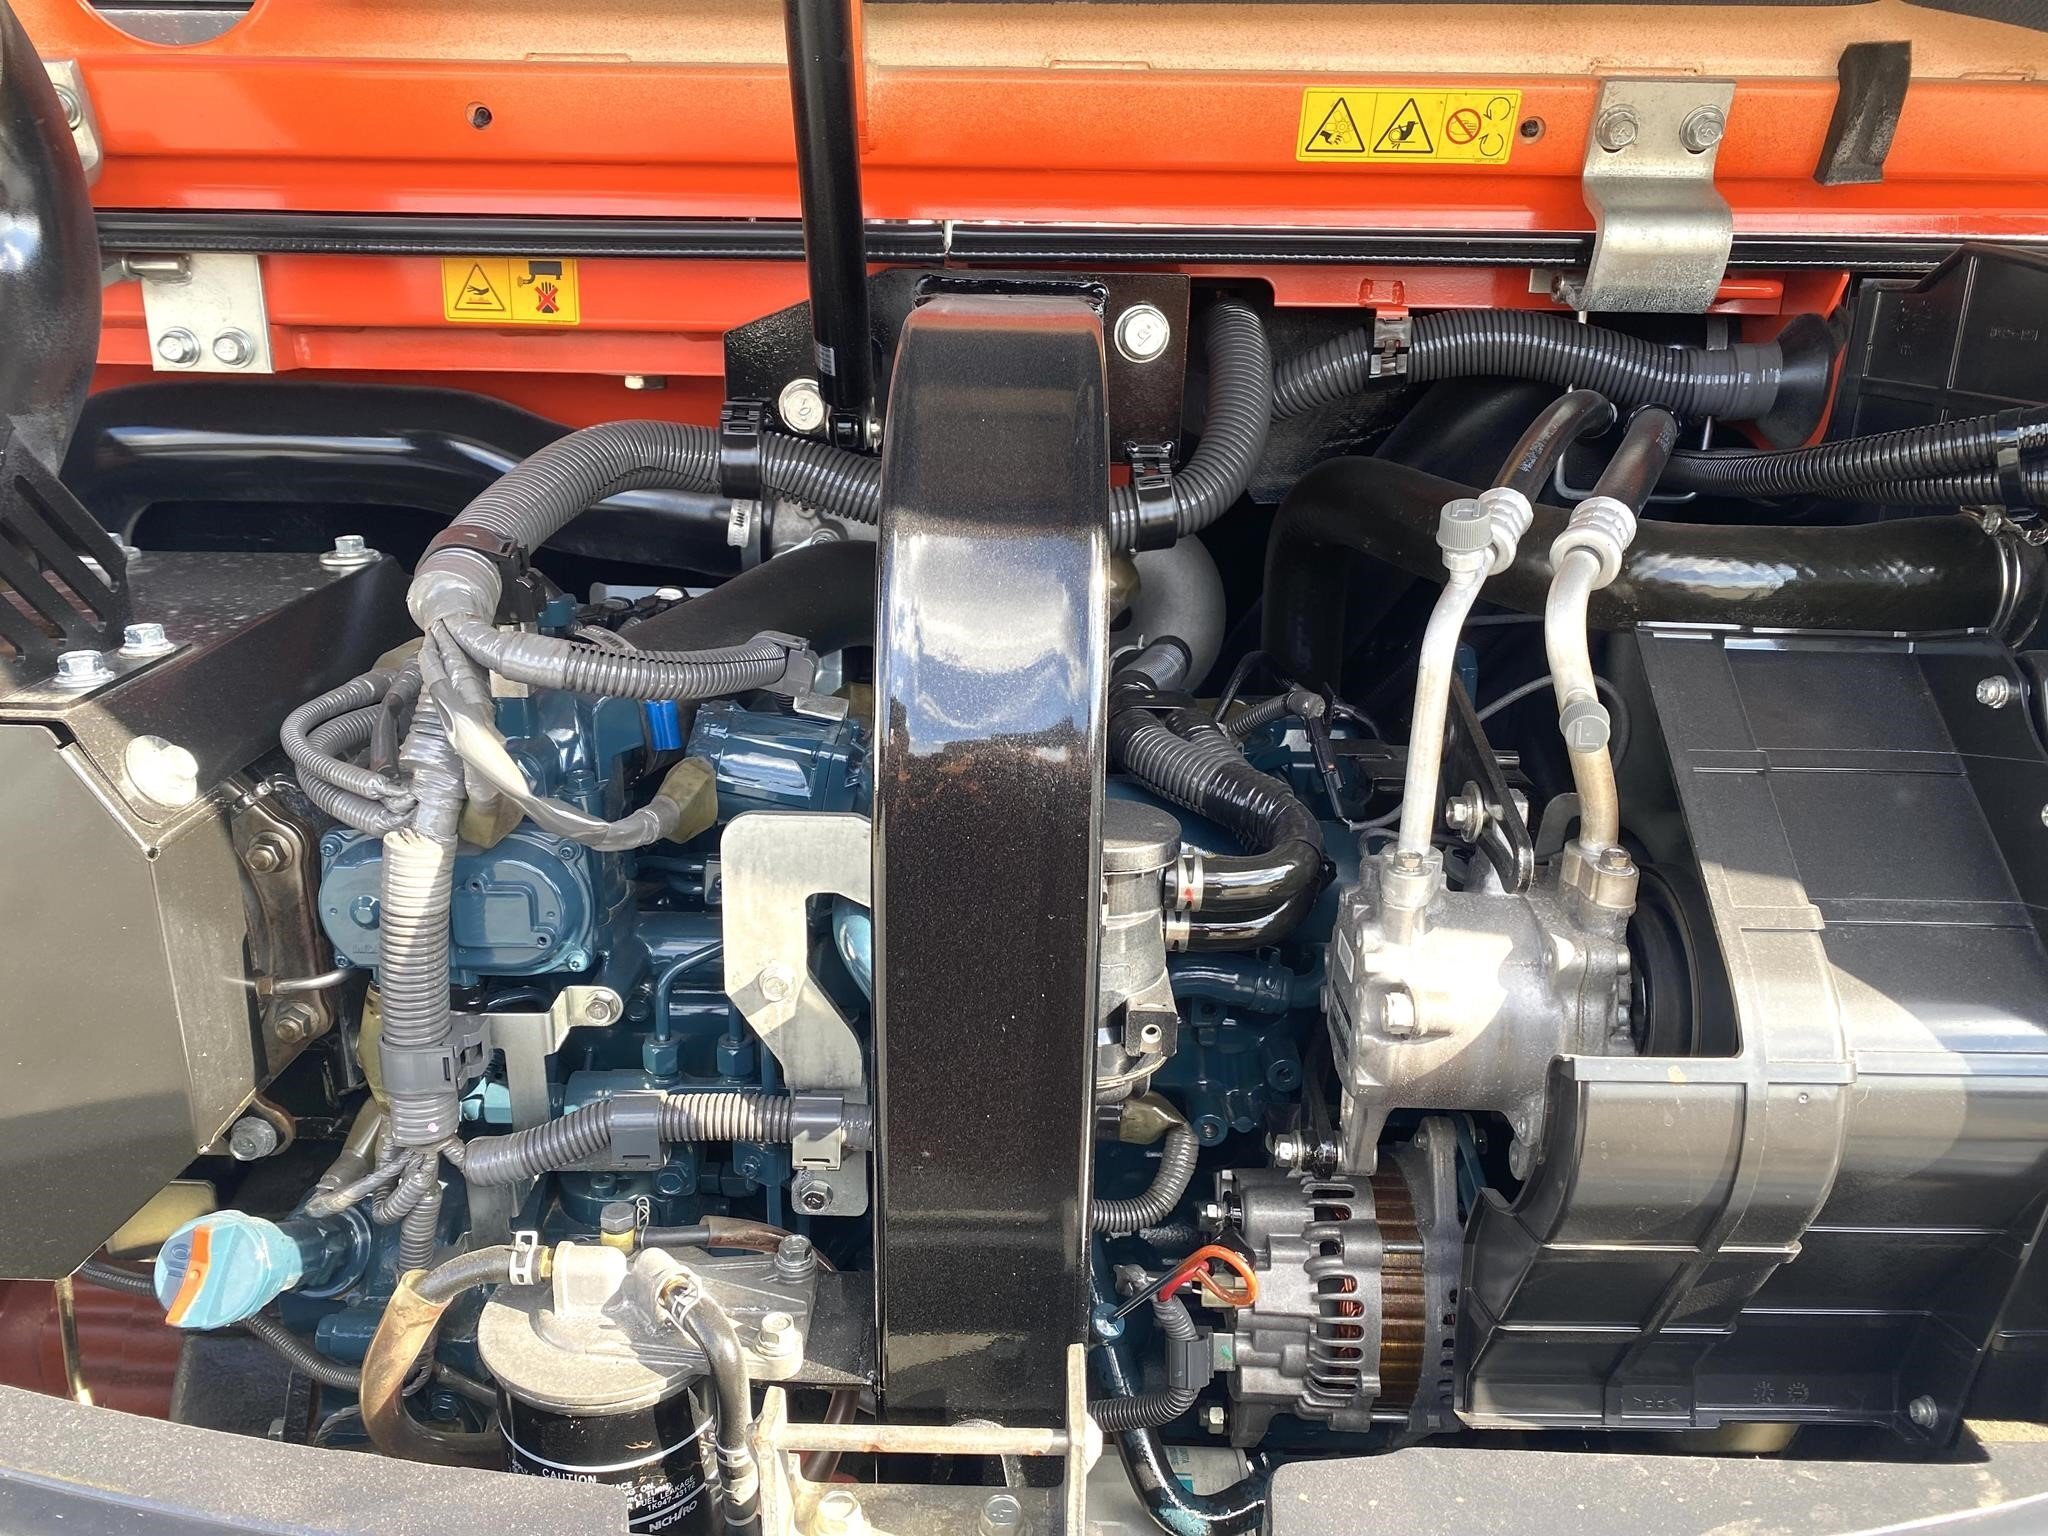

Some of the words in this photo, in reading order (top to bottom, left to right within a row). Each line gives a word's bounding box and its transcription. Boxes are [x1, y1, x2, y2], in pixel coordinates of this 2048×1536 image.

[1450, 501, 1480, 517] H
[1575, 721, 1600, 747] L
[541, 1468, 598, 1484] CAUTION
[611, 1481, 633, 1490] ACE
[635, 1496, 657, 1508] FUEL
